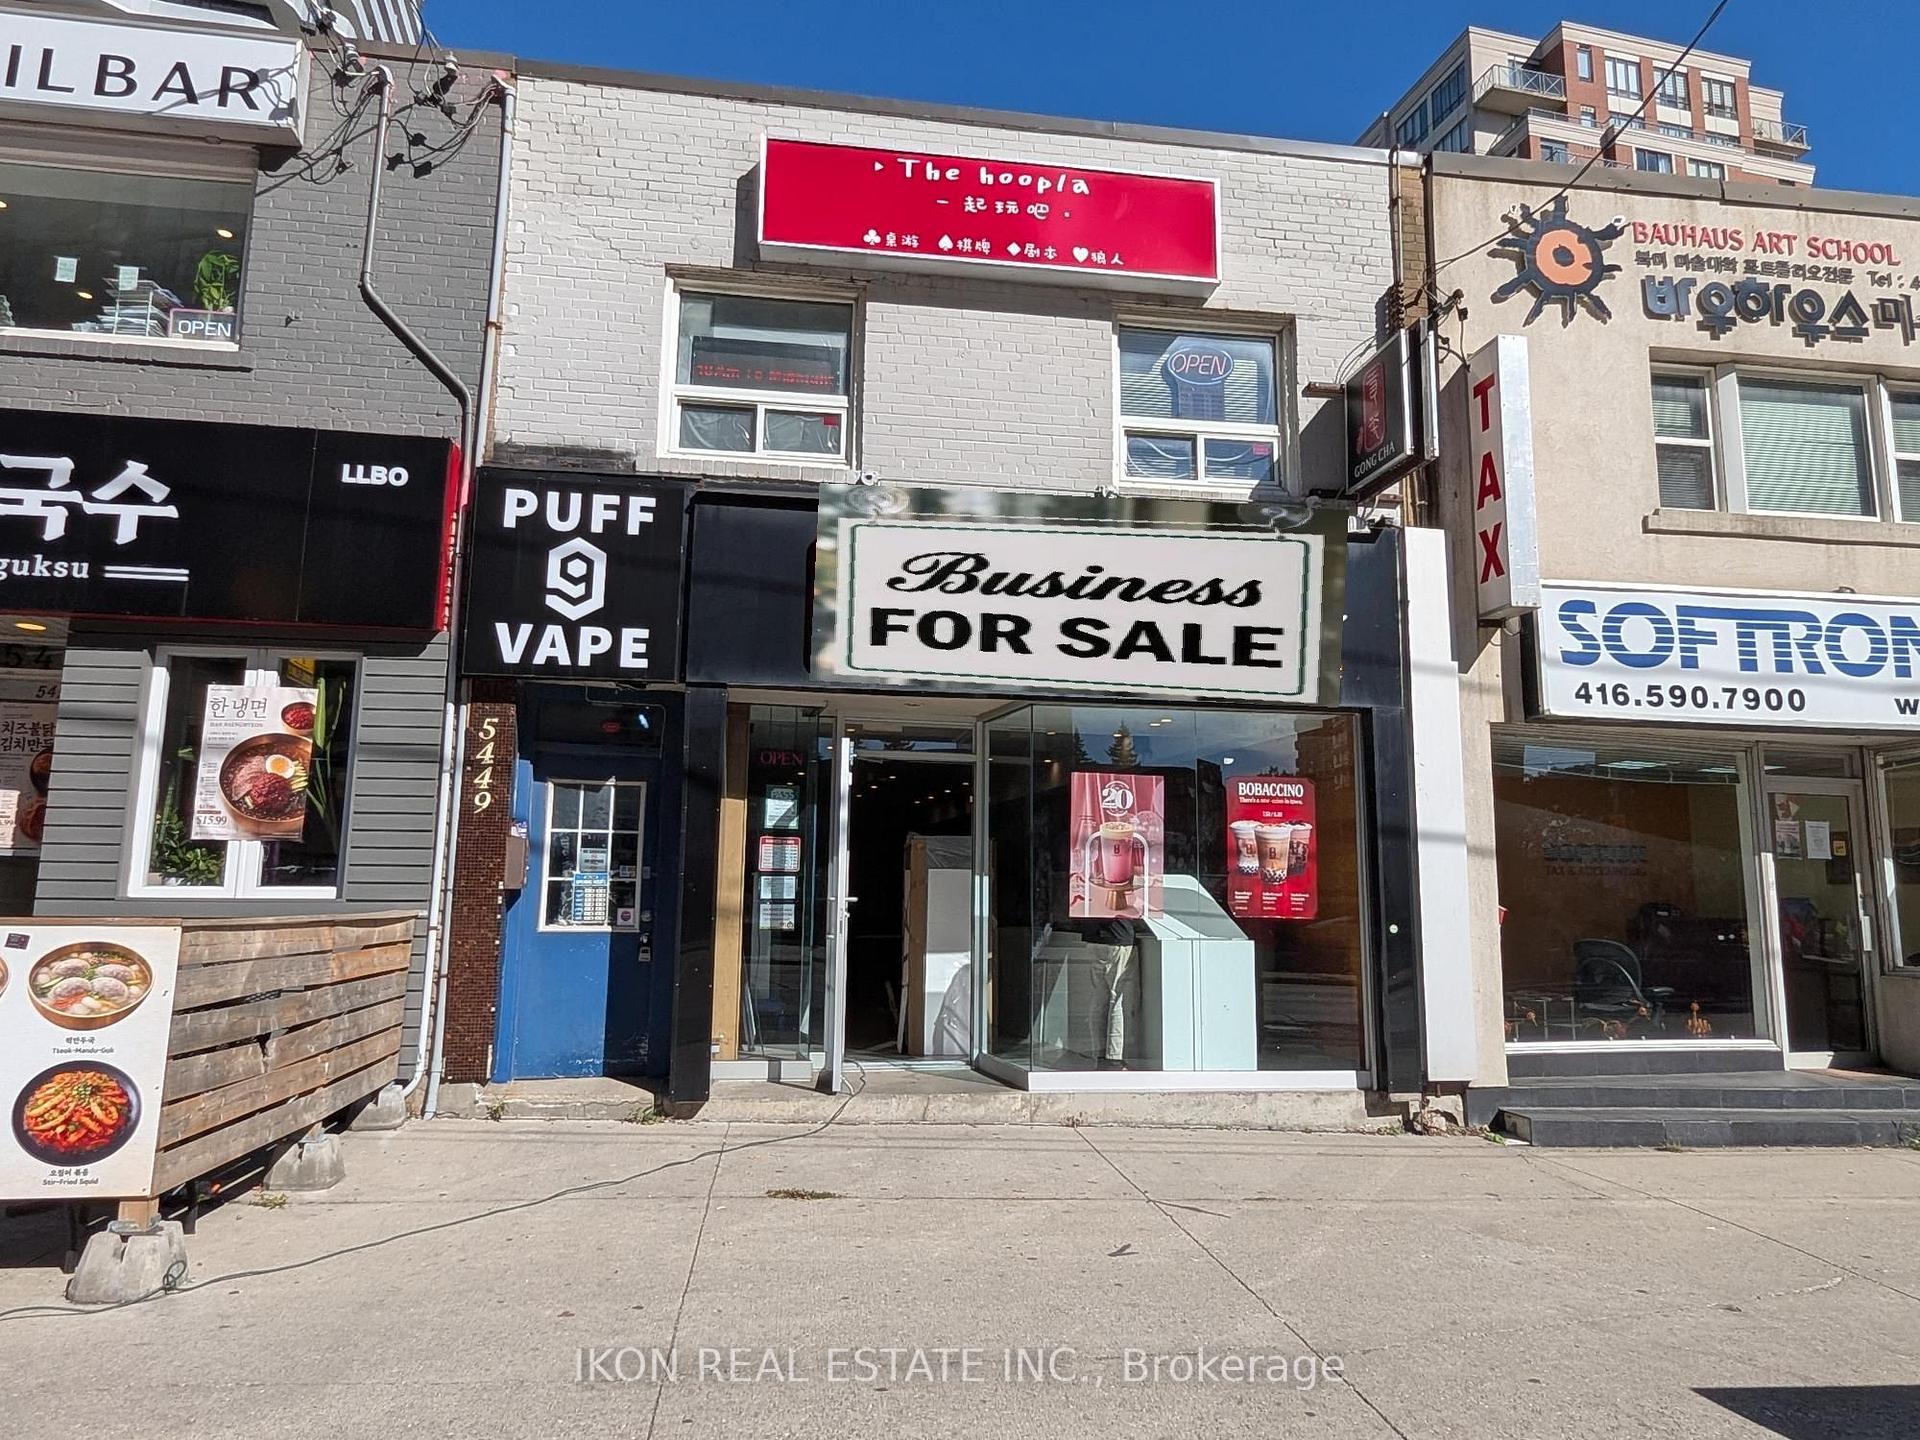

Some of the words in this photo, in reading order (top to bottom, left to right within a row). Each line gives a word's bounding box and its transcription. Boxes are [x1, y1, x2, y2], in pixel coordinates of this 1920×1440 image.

[5, 44, 260, 110] ILBAR
[897, 157, 960, 182] The
[979, 166, 1090, 195] hoopla
[1632, 221, 1744, 251] BAUHAUS
[1751, 231, 1799, 257] ART
[1807, 238, 1901, 266] SCHOOL
[1866, 270, 1892, 287] Tel
[178, 320, 231, 337] OPEN
[1171, 353, 1227, 375] OPEN
[341, 463, 409, 487] LLBO
[1354, 454, 1377, 478] GONG
[1378, 440, 1396, 465] CHA
[1473, 372, 1505, 584] TAX
[503, 488, 656, 536] PUFF
[885, 551, 1262, 608] Business
[495, 622, 650, 669] VAPE
[870, 607, 1032, 655] FOR
[1056, 616, 1283, 669] SALE
[1575, 681, 1807, 712] 416.590.7900
[473, 717, 499, 814] 5449
[760, 751, 803, 766] OPEN
[770, 790, 795, 800] PASS
[1101, 788, 1133, 809] 20
[1238, 782, 1304, 797] BOBACCINO
